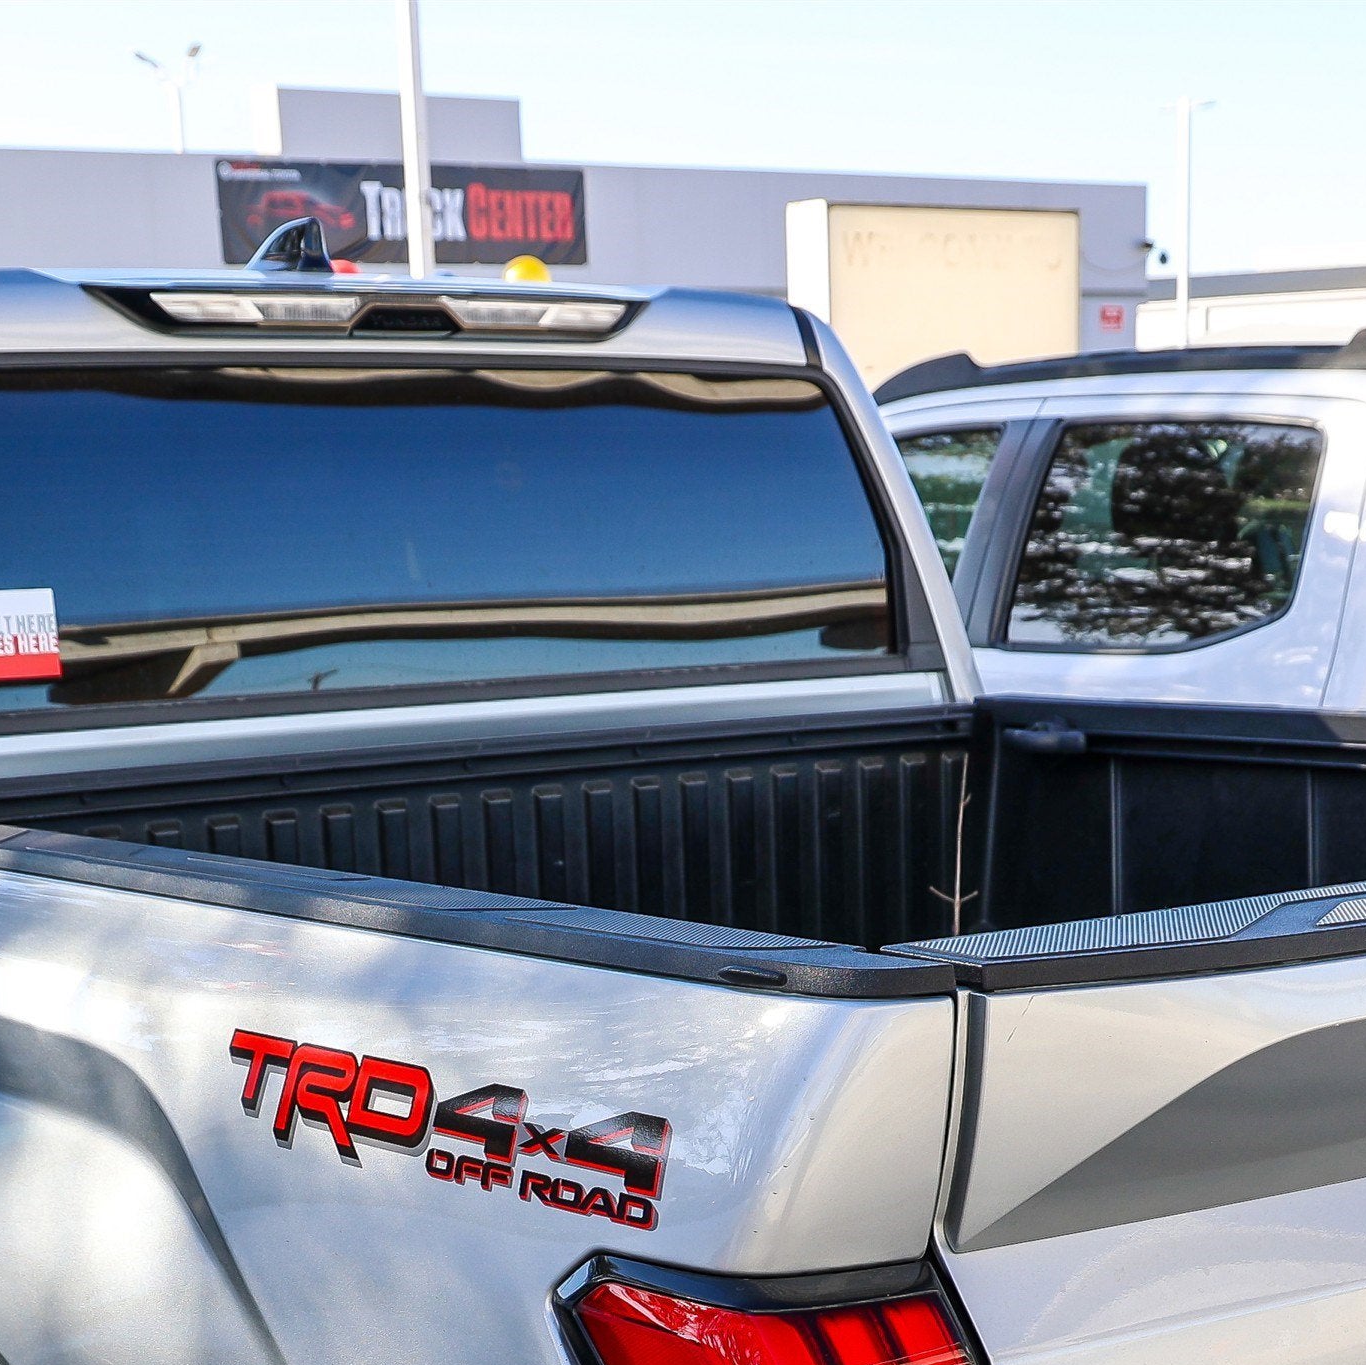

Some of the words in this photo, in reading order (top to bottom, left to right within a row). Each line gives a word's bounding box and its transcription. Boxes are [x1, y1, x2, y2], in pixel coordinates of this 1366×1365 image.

[467, 182, 575, 243] CENTER
[14, 614, 57, 635] HERE
[17, 632, 60, 655] HERE
[229, 1028, 436, 1167] TRD
[426, 1147, 515, 1191] OFF
[519, 1169, 660, 1231] ROAD
